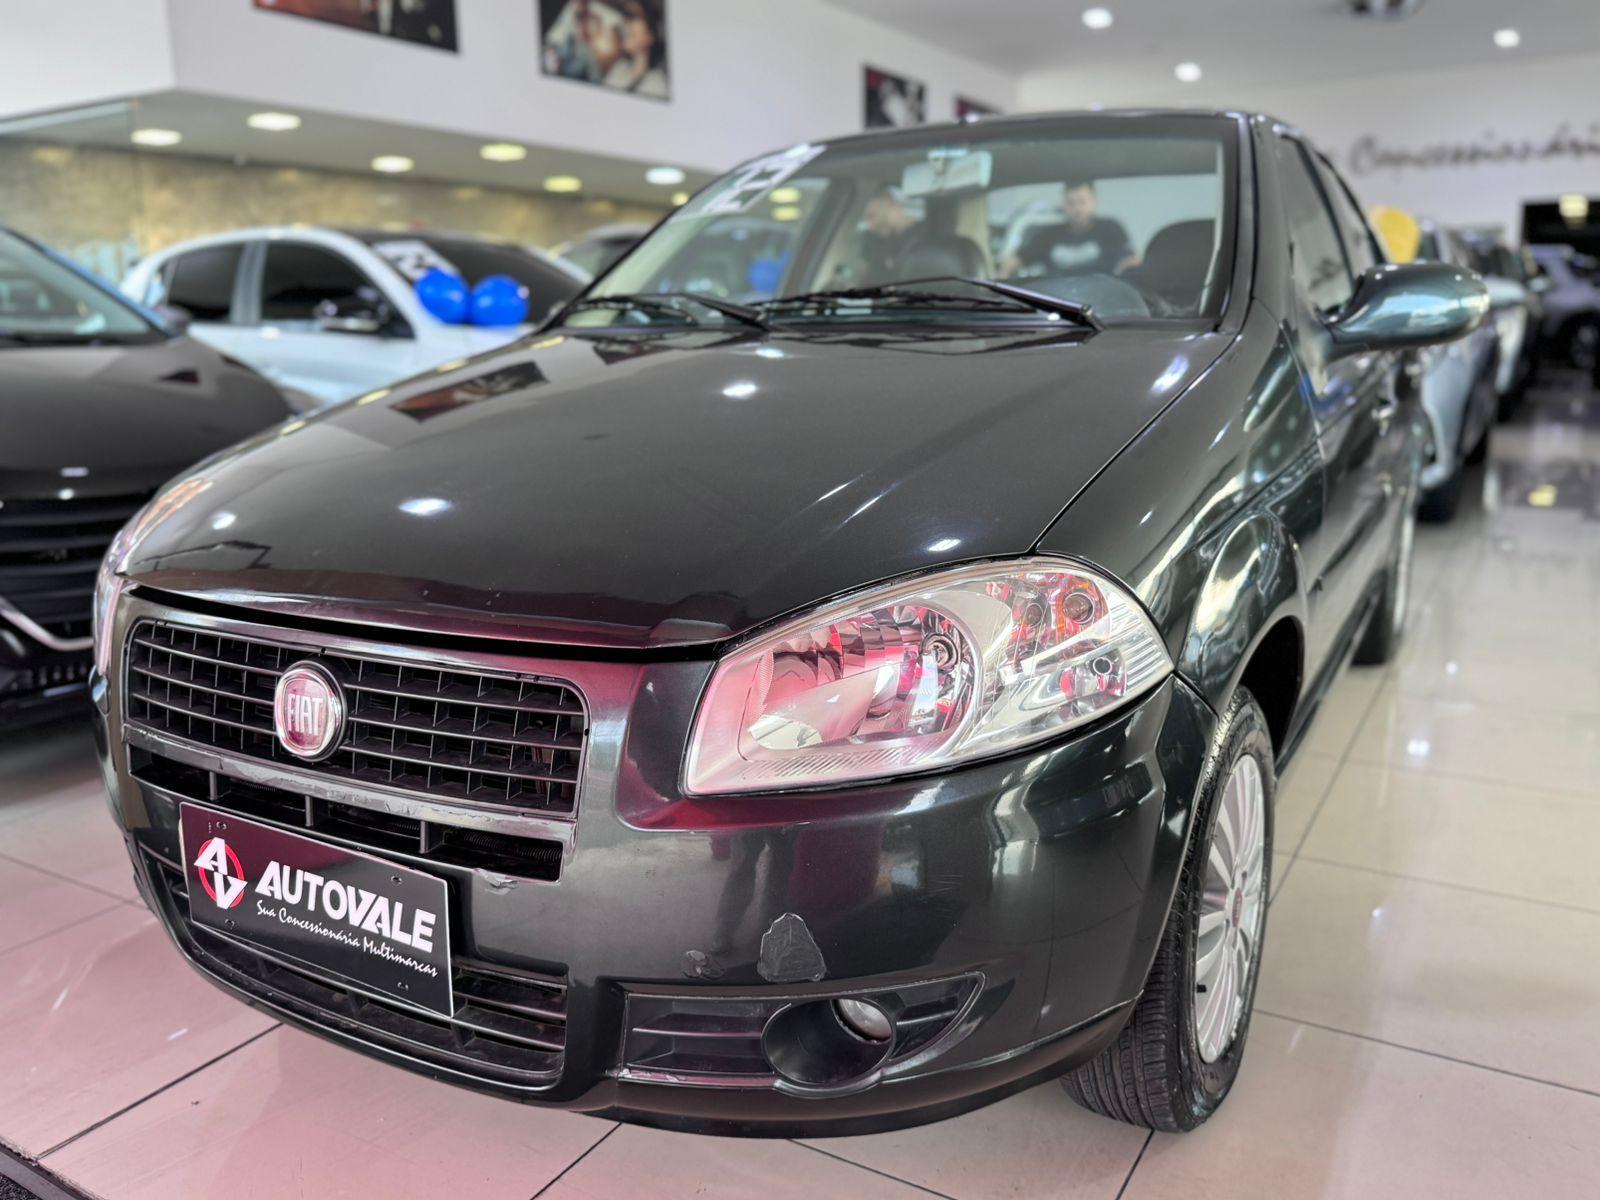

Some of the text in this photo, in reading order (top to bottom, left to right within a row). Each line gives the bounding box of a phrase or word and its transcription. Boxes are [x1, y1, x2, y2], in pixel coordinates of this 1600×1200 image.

[287, 693, 324, 736] FIAT
[255, 860, 437, 953] AUTOVALE
[256, 899, 439, 978] Sua Concessionária Multimarcas
